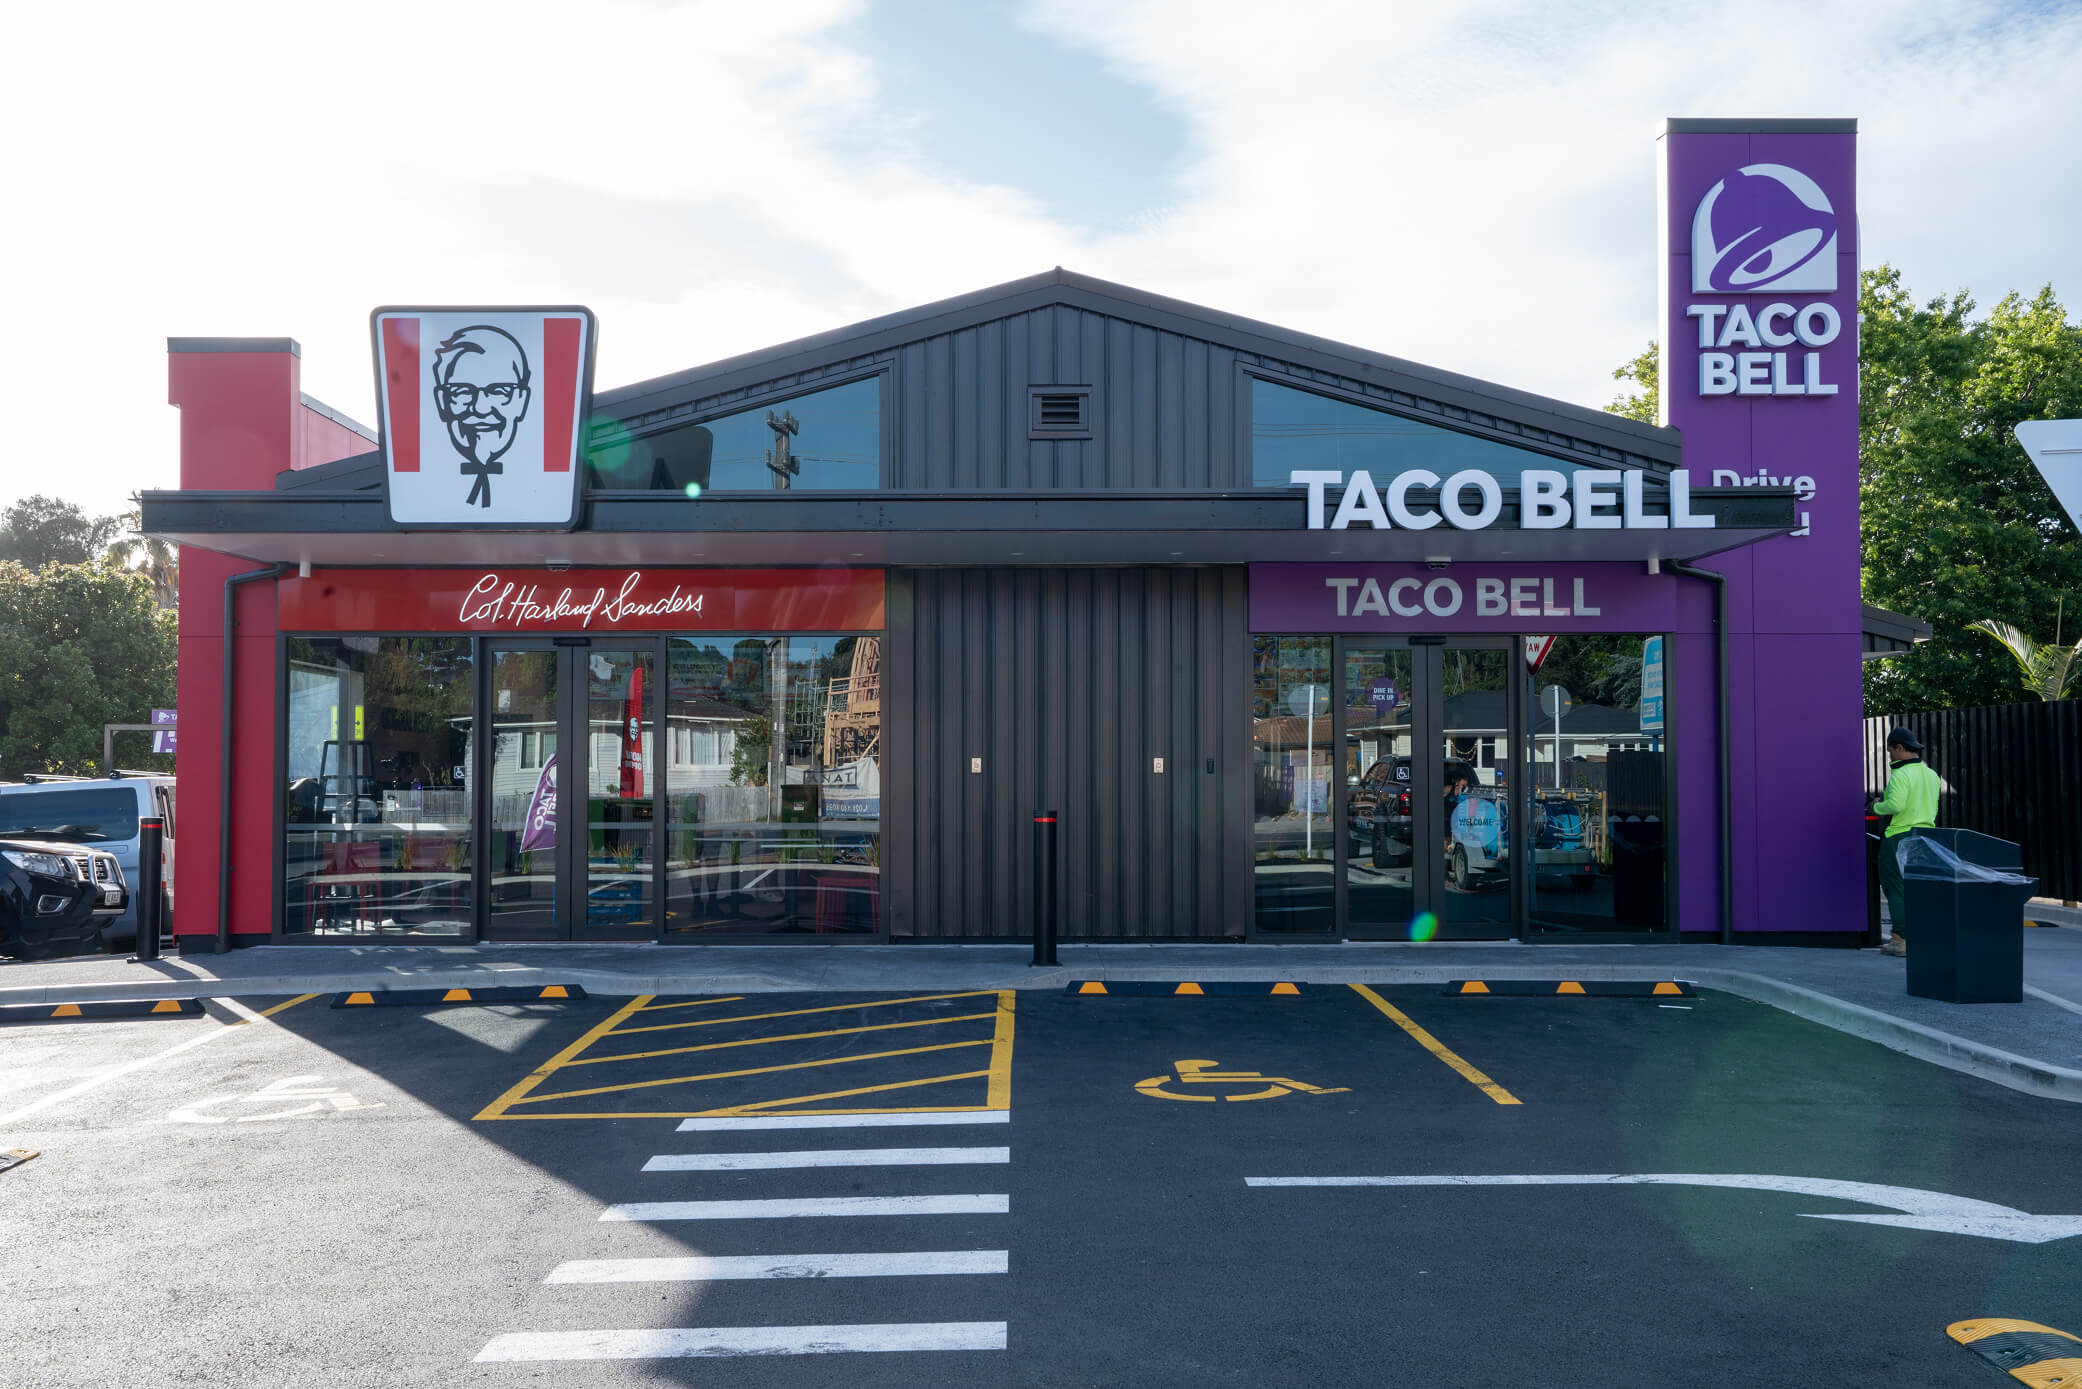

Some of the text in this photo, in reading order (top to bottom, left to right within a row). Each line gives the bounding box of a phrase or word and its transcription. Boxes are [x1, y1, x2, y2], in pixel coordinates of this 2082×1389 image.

[1687, 302, 1841, 347] TACO
[1698, 352, 1839, 396] BELL
[1290, 468, 1502, 531] TACO
[1520, 468, 1716, 530] BELL
[508, 584, 605, 628] Harland
[1325, 577, 1602, 618] TACO BELL
[1458, 817, 1493, 827] WELCOME
